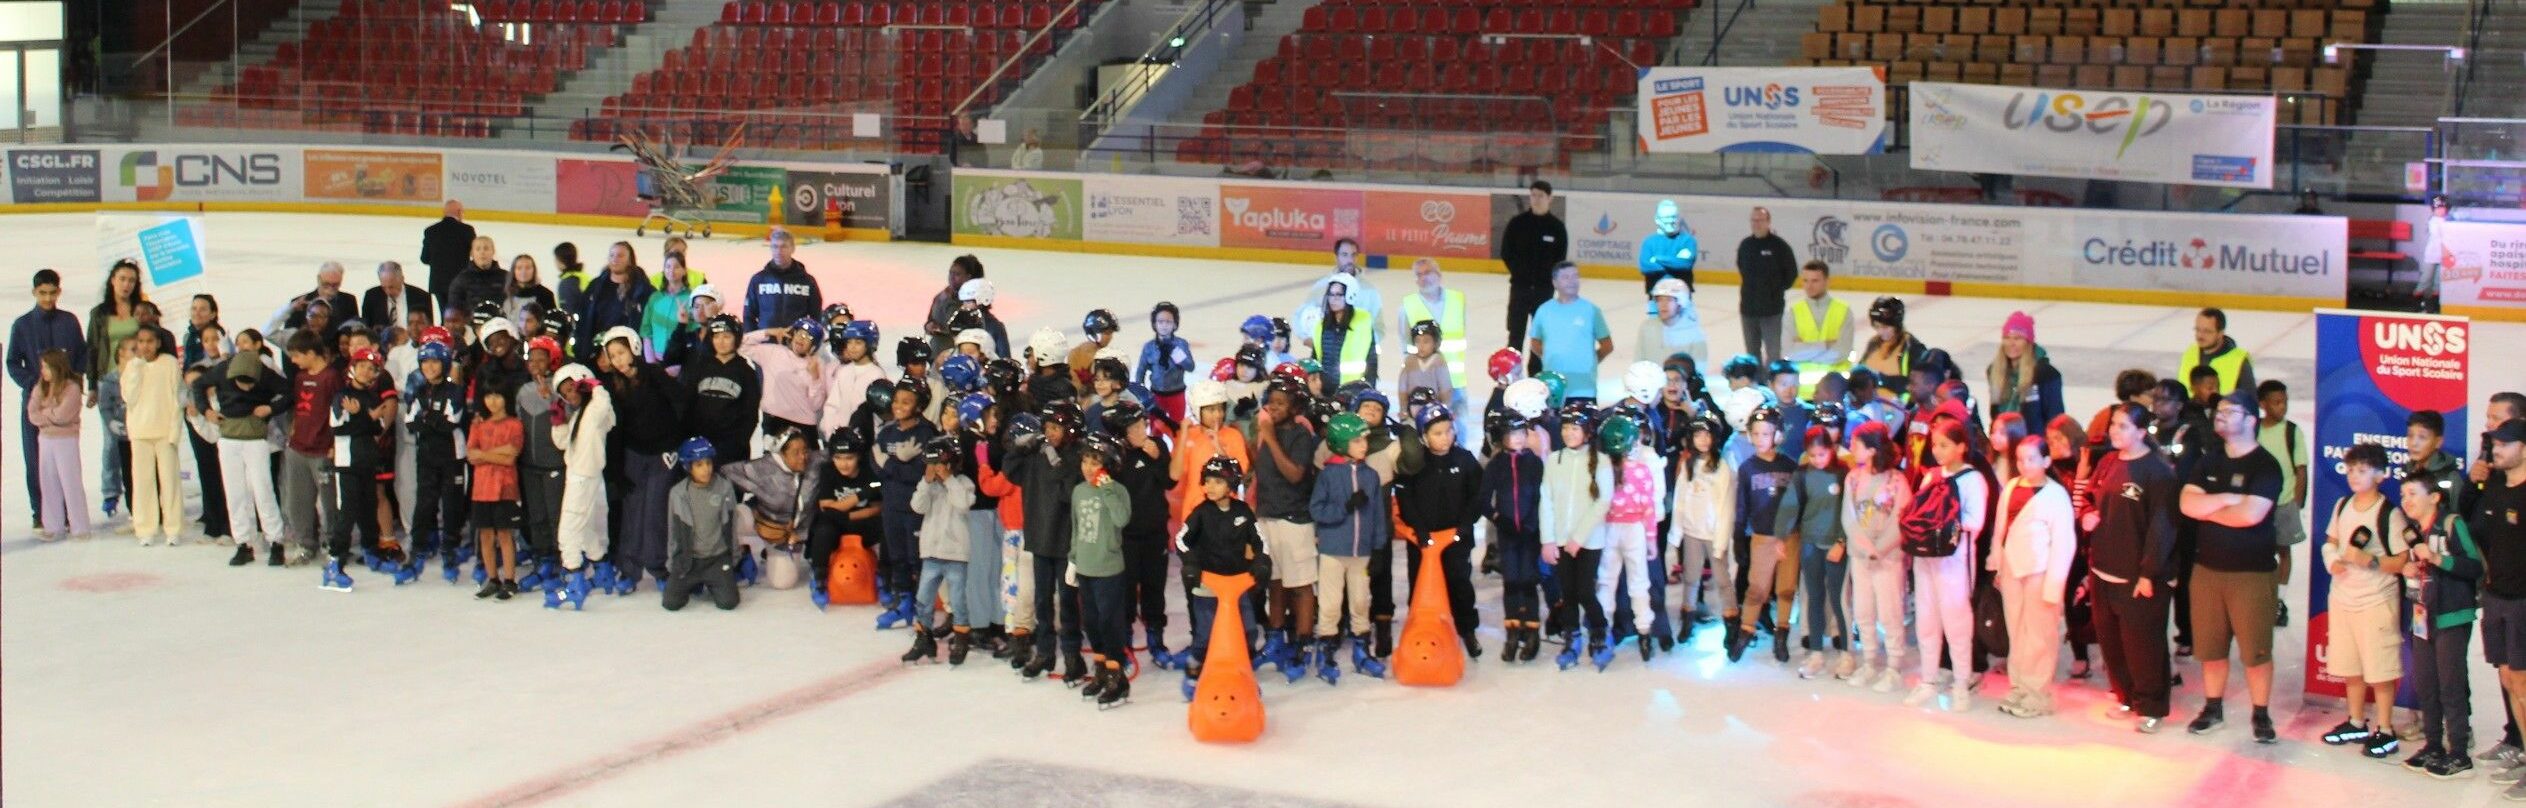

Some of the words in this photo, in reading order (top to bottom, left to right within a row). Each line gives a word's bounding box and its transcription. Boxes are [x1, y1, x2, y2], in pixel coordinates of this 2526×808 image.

[1723, 83, 1800, 110] UNSS
[2003, 92, 2172, 160] usep
[17, 154, 94, 169] CSGL.FR
[175, 153, 280, 187] CNS
[451, 172, 507, 185] NOVOTEL
[1223, 198, 1326, 231] Yapluka
[2490, 240, 2506, 248] Du
[2510, 240, 2526, 248] rir
[2083, 237, 2177, 267] Crédit
[2219, 244, 2329, 276] Mutuel
[2375, 321, 2466, 356] UNSS
[2376, 365, 2391, 375] du
[2391, 366, 2421, 378] Sport
[2422, 368, 2464, 381] Scolaire
[2379, 354, 2411, 365] Union
[2411, 356, 2462, 370] Nationale
[2352, 432, 2409, 449] ENSEM
